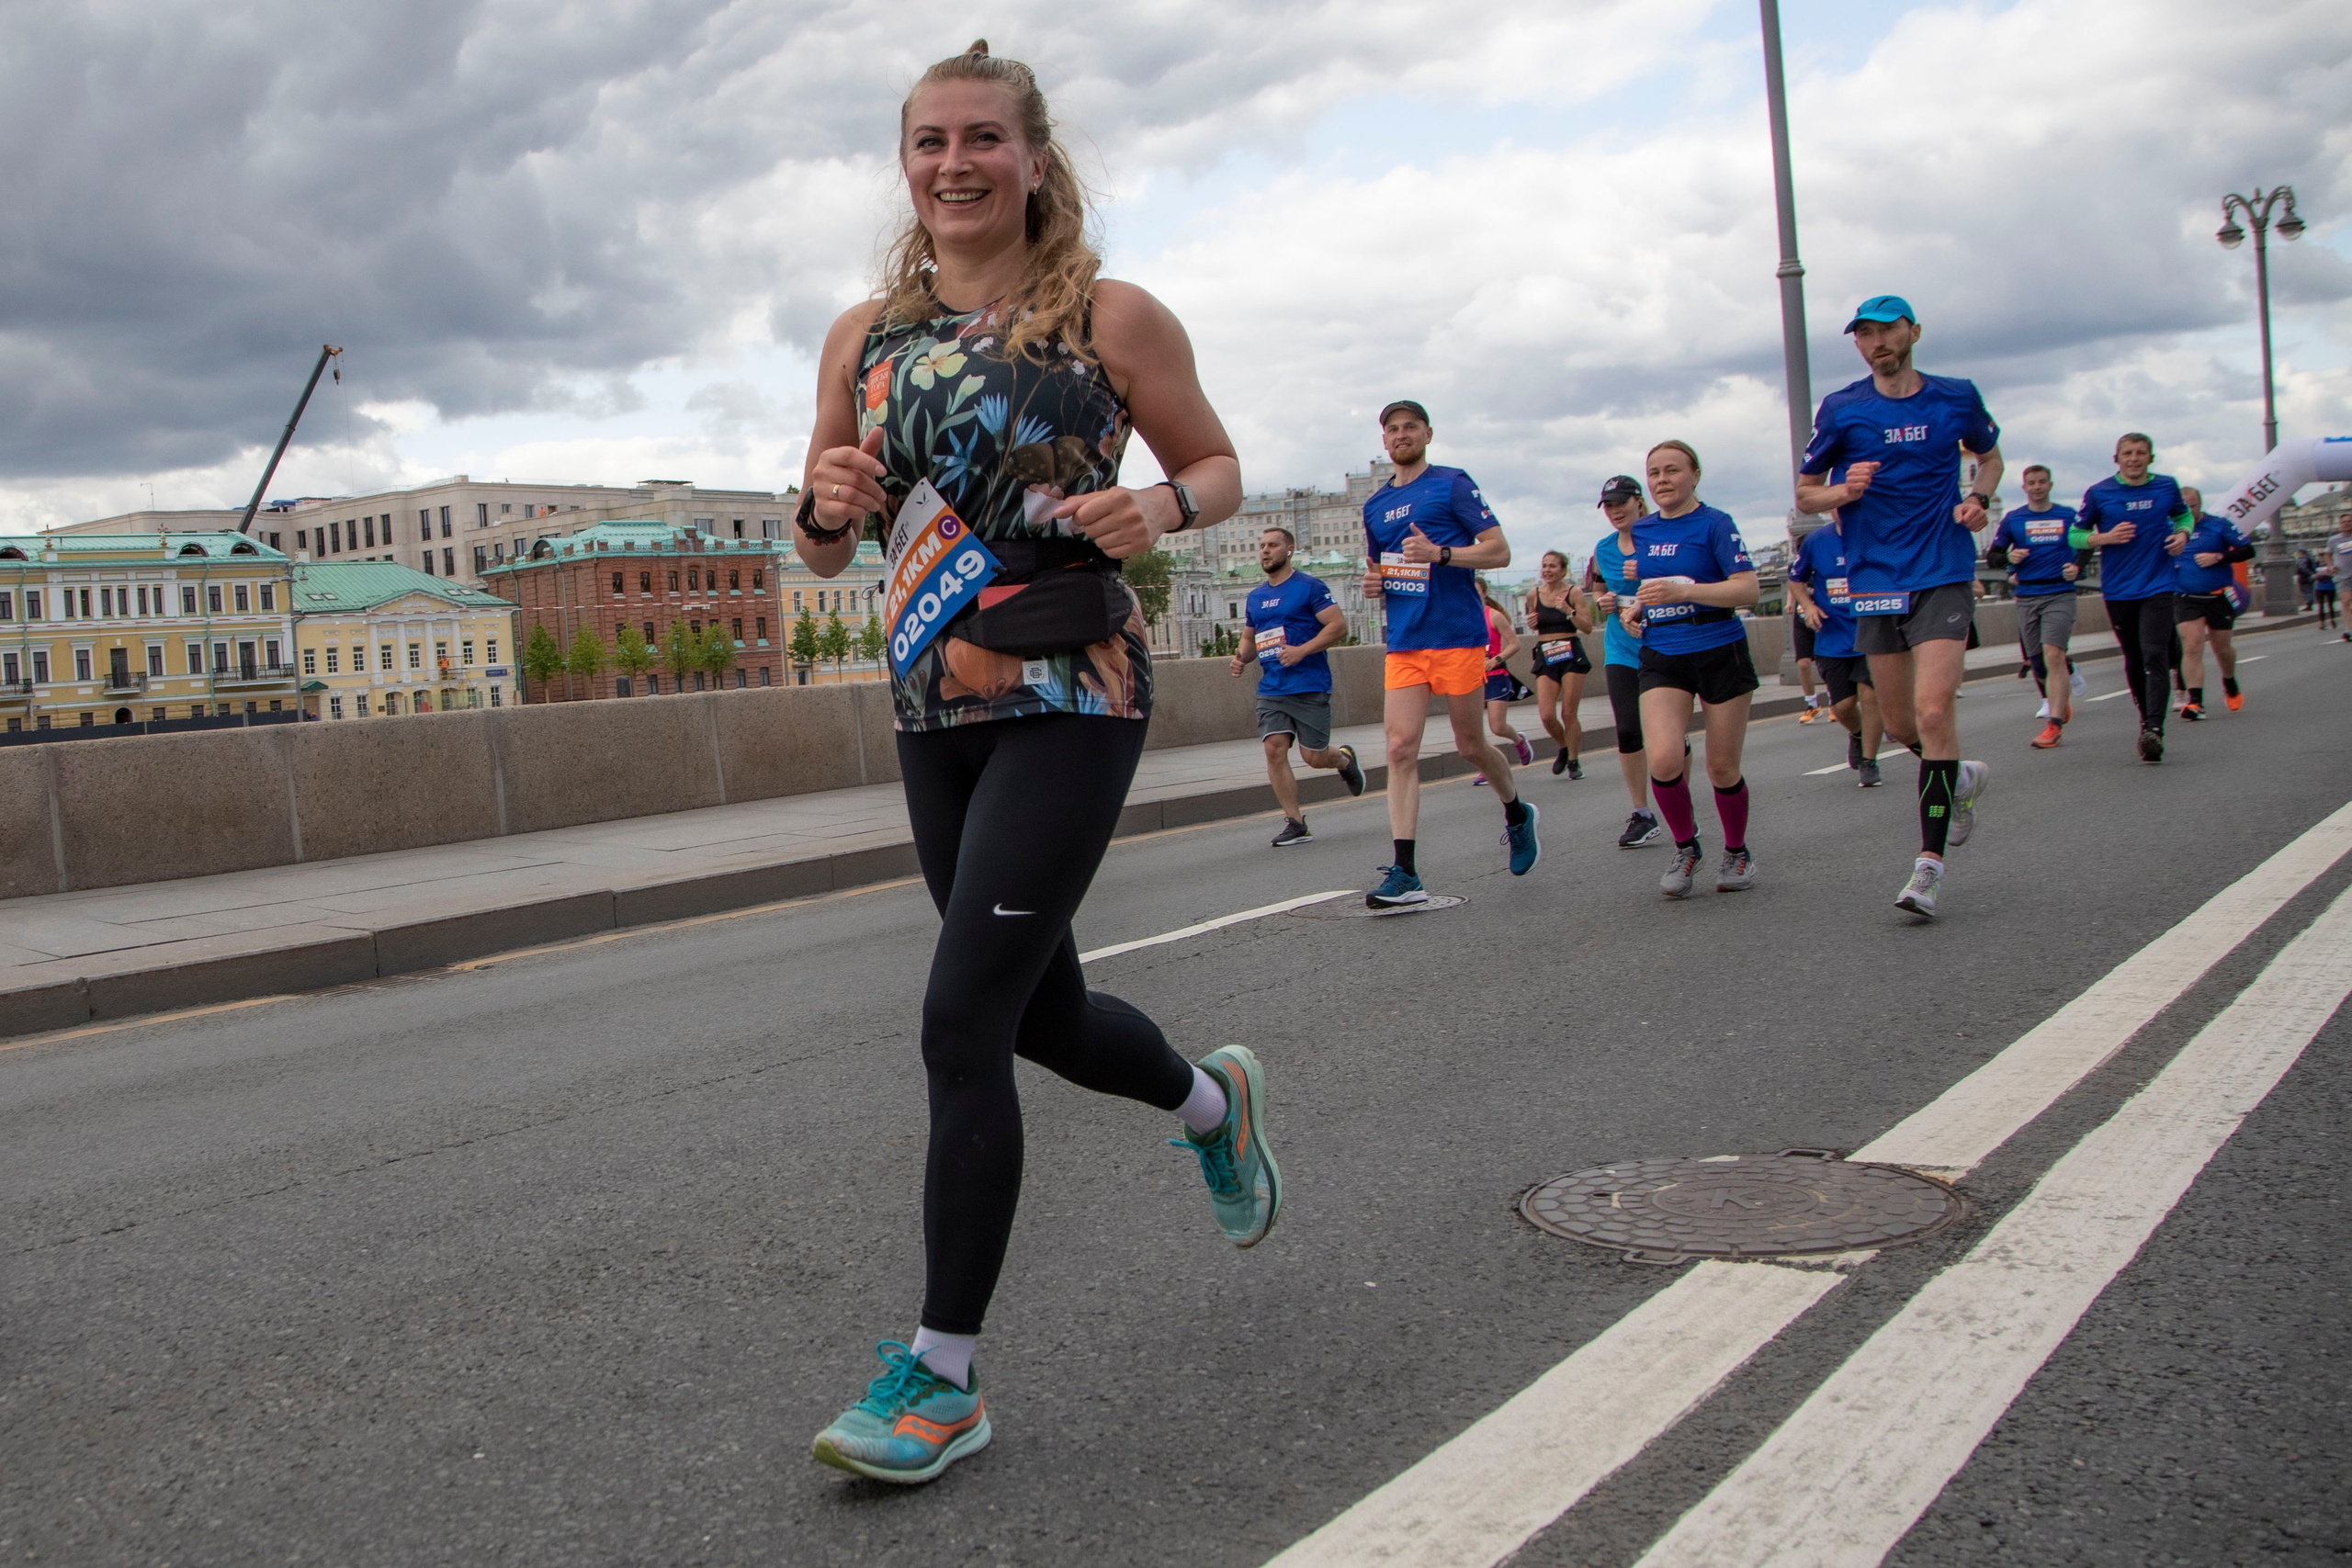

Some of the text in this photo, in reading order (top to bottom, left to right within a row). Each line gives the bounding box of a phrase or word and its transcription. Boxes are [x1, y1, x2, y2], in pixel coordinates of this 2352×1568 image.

[1384, 580, 1426, 592] 00103
[894, 549, 986, 662] 02049
[1647, 604, 1696, 619] 02801
[1855, 598, 1903, 613] 02125
